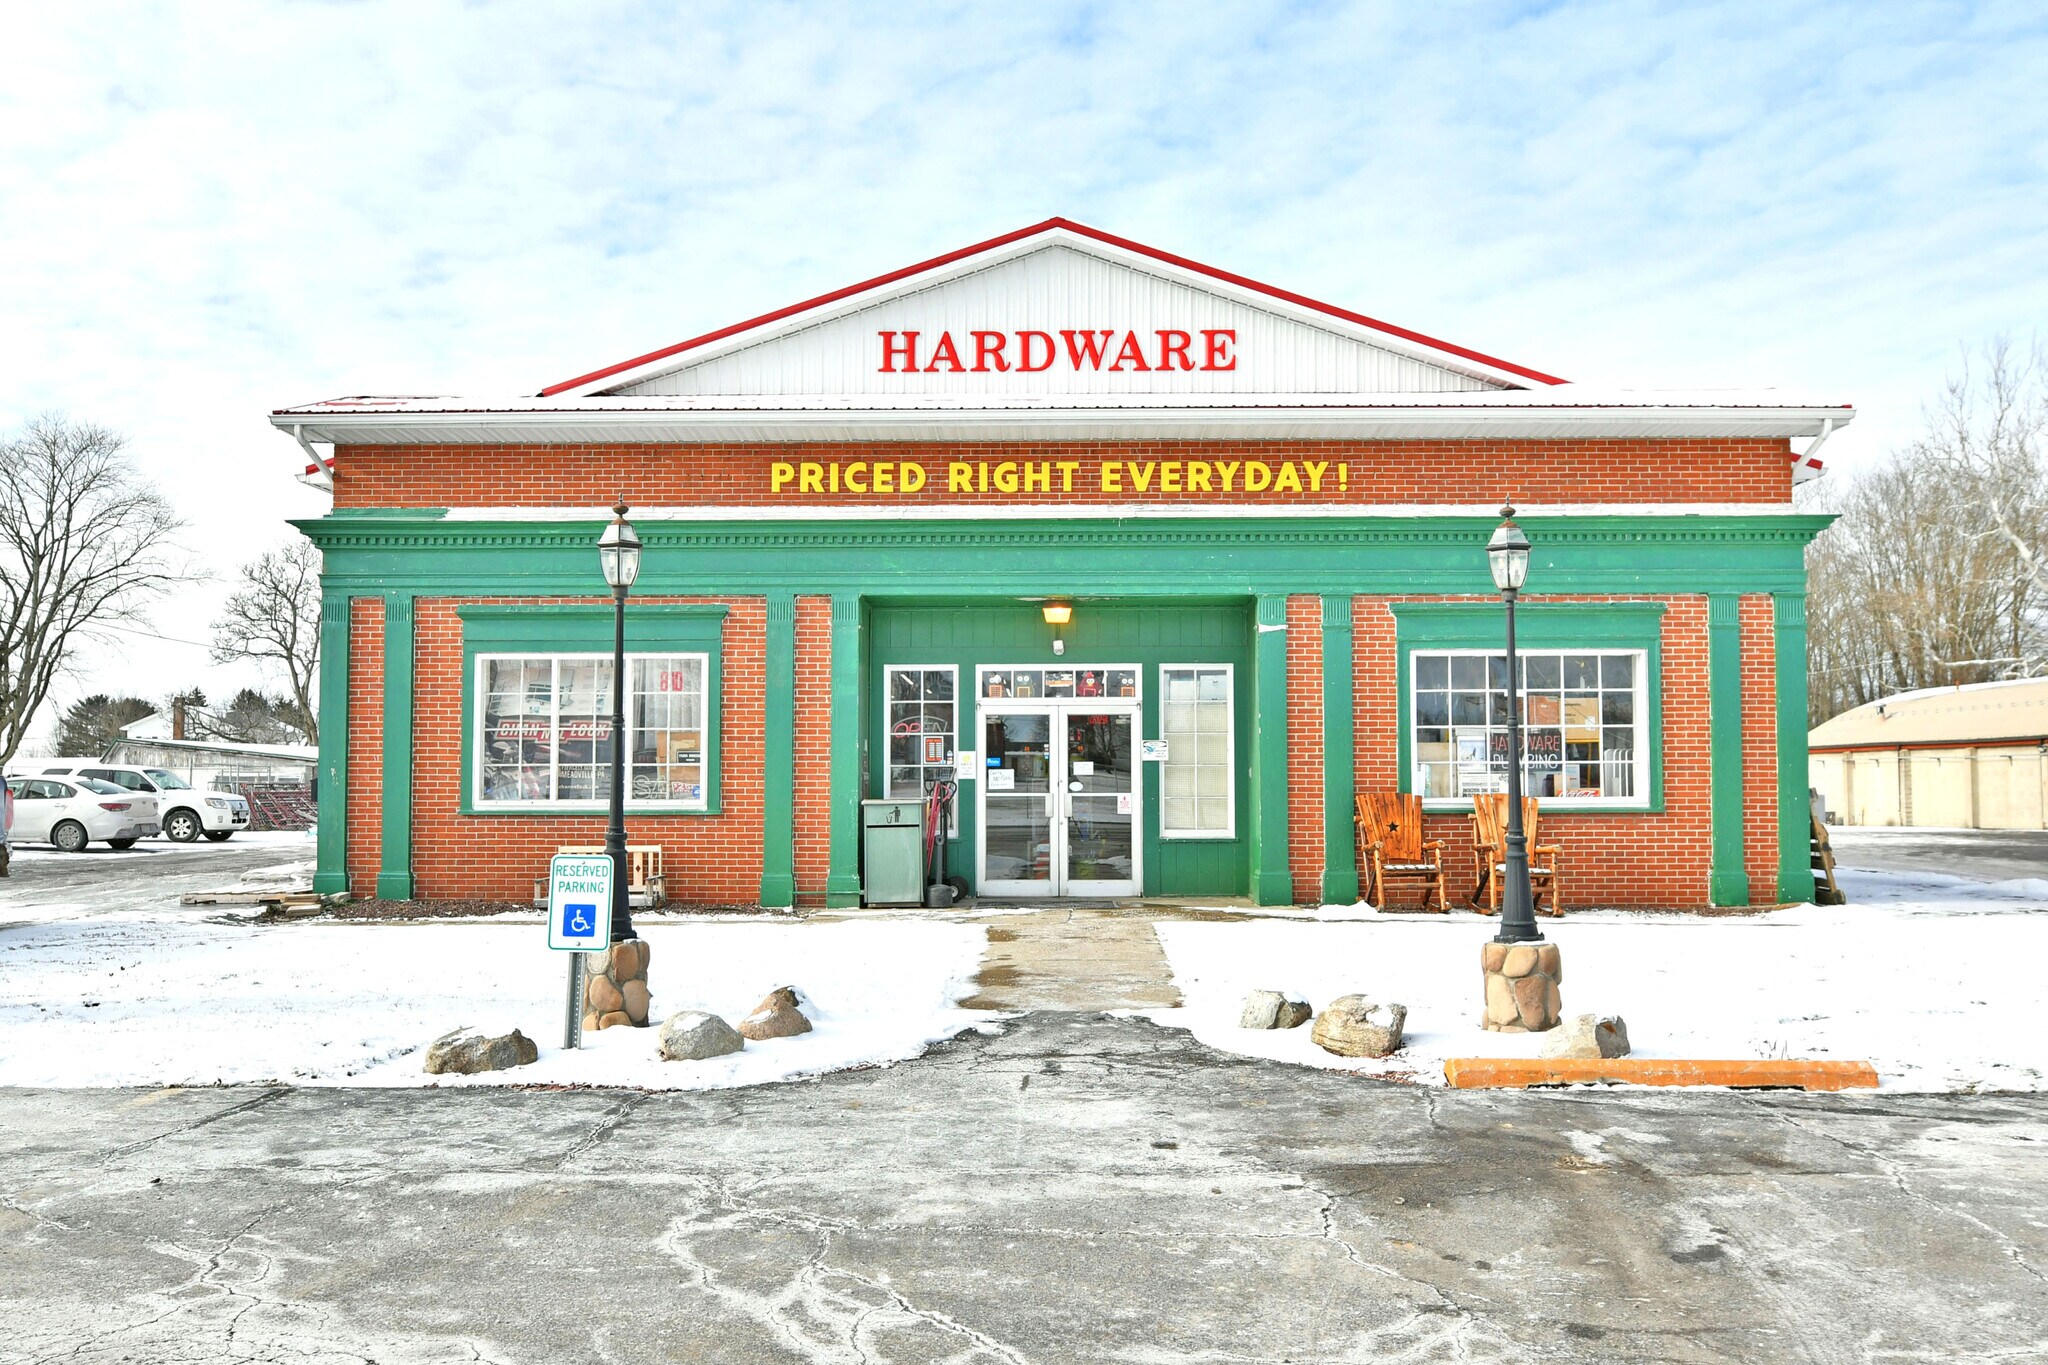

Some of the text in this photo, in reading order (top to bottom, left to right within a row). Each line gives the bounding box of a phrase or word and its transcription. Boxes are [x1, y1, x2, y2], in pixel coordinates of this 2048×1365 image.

[878, 330, 1236, 372] HARDWARE
[771, 461, 1347, 493] PRICED RIGHT EVERYDAY!
[499, 723, 607, 740] CHANNLLOCK
[894, 721, 947, 738] OPEN
[1490, 735, 1560, 751] HADWARE
[1493, 754, 1558, 769] PLMBING
[555, 865, 609, 877] RESERVED
[558, 881, 605, 893] PARKING
